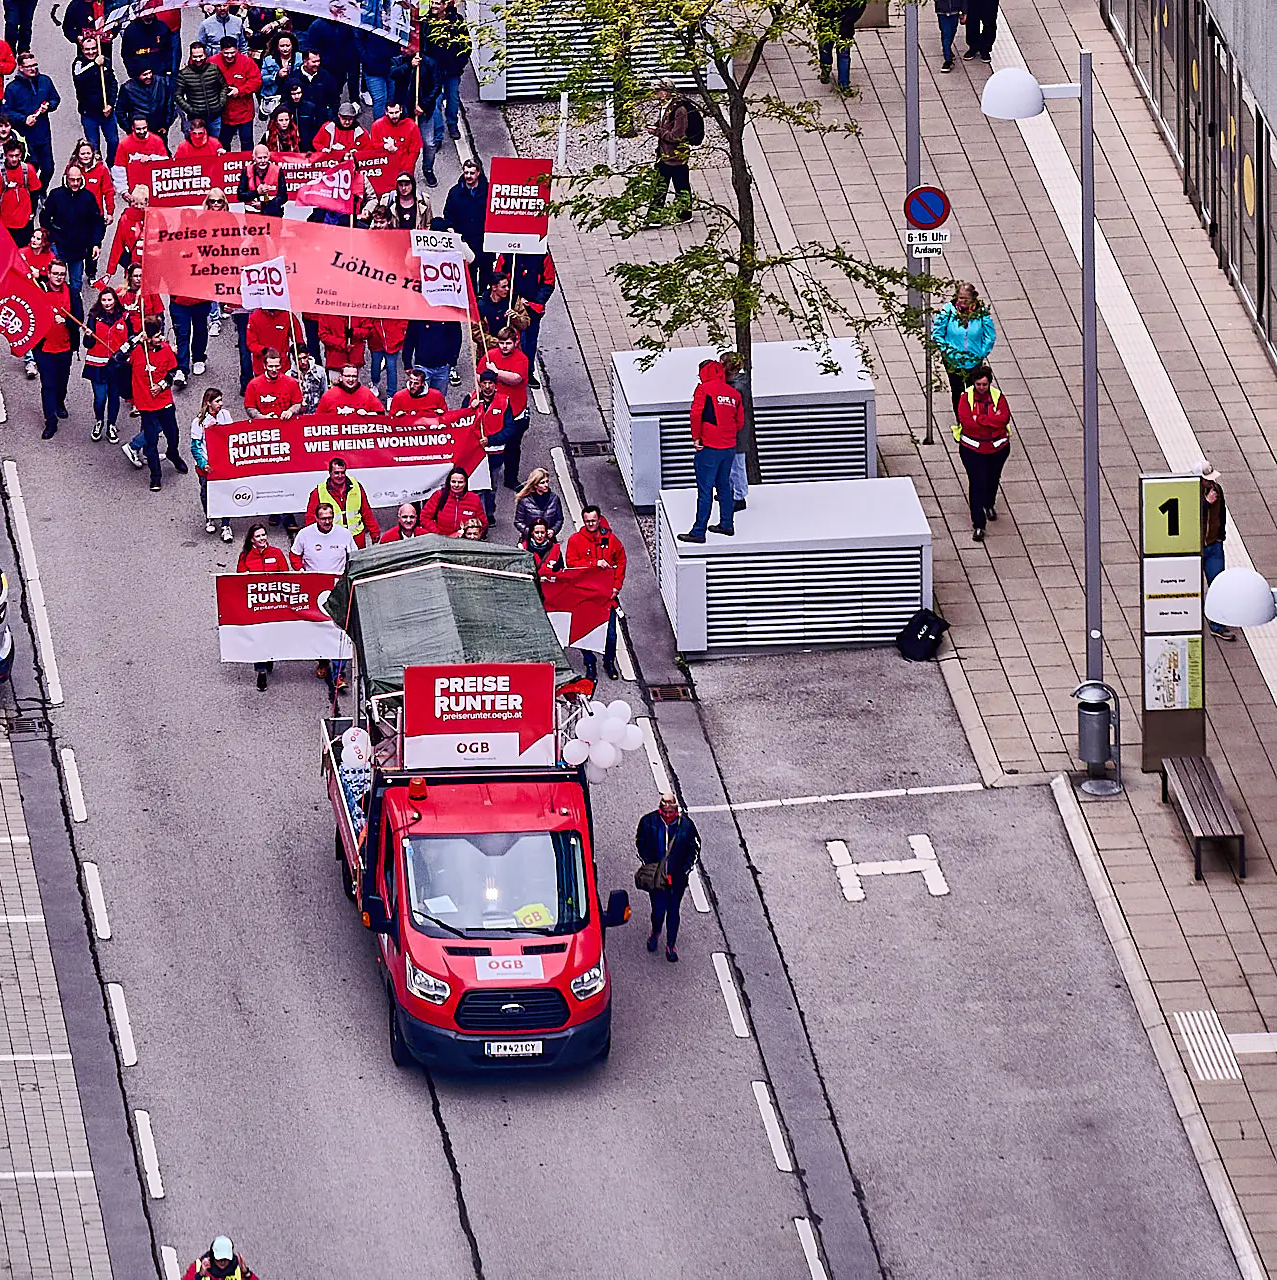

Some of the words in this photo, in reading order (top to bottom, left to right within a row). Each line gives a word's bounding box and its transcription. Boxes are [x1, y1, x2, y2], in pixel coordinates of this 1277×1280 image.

[152, 165, 202, 183] PREISE
[224, 162, 239, 171] ICH
[153, 177, 211, 196] RUNTER
[491, 184, 538, 200] PREISE
[491, 197, 545, 213] RUNTER
[159, 227, 207, 243] Preise
[212, 222, 271, 238] runter!
[907, 233, 927, 242] 6-15
[932, 232, 948, 242] Uhr
[415, 235, 454, 248] PRO-GE
[197, 245, 260, 258] Wohnen
[914, 246, 941, 255] Anfang
[331, 251, 397, 285] Löhne
[317, 288, 337, 296] Dein
[314, 298, 400, 311] Arbeiterbetriebsrat
[304, 425, 339, 437] EURE
[341, 423, 392, 435] HERZEN
[229, 429, 280, 447] PREISE
[304, 440, 330, 452] WIE
[332, 438, 374, 451] MEINE
[229, 443, 290, 463] RUNTER
[1158, 497, 1179, 536] 1
[247, 581, 300, 594] PREISE
[247, 593, 309, 608] RUNTER
[435, 676, 510, 696] PREISE
[435, 694, 522, 718] RUNTER
[443, 711, 522, 721] preiserunter.oegb.at
